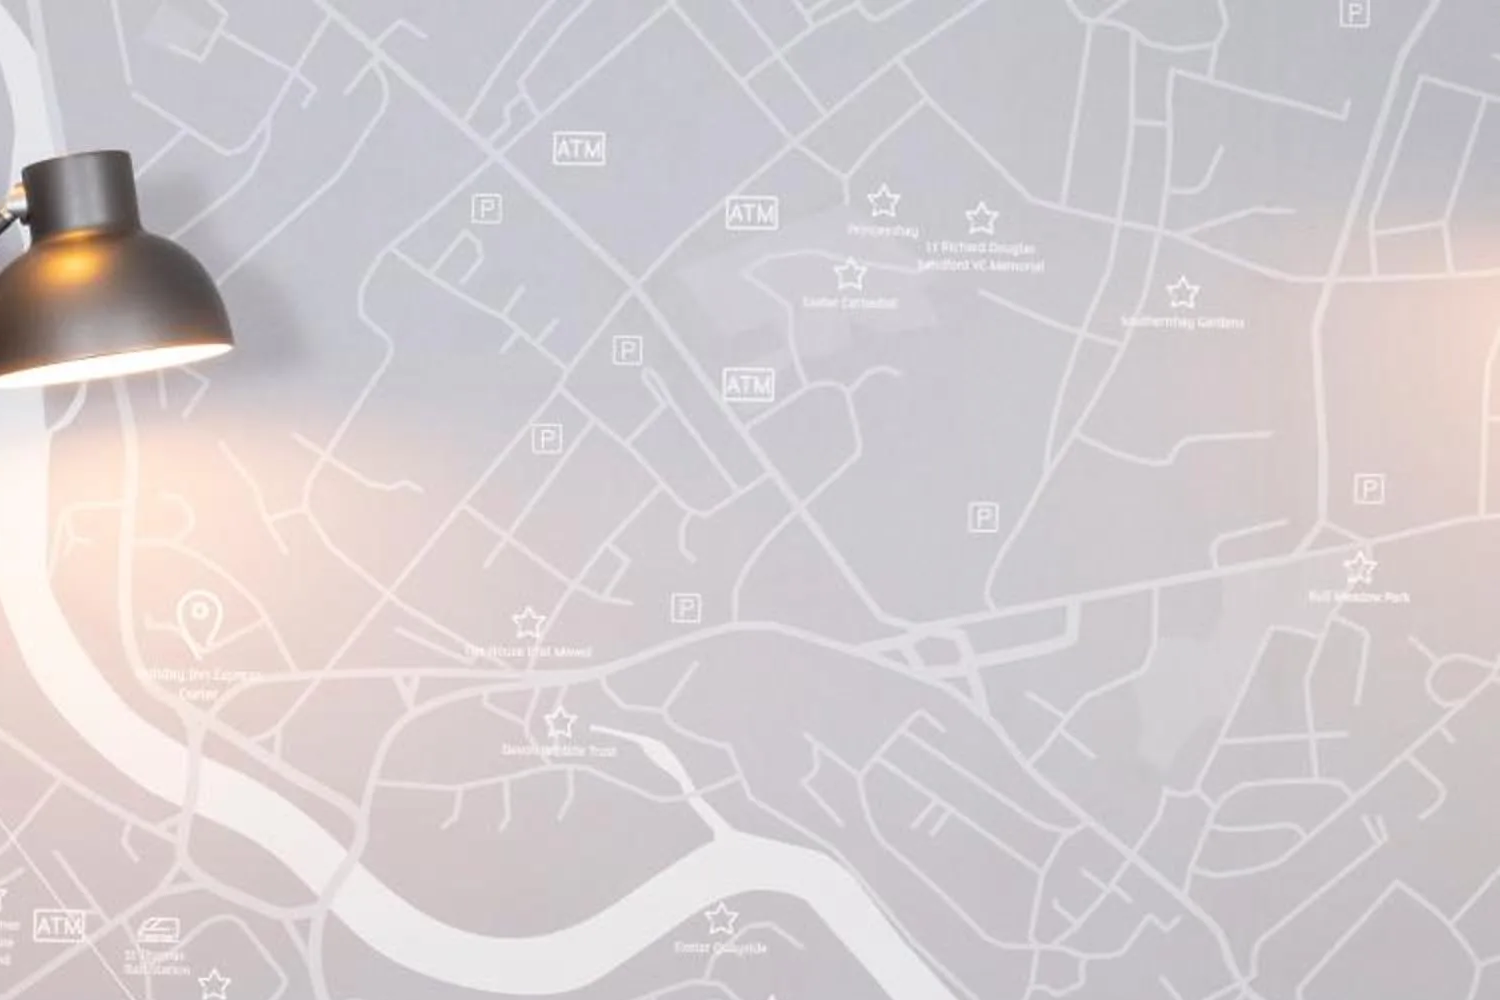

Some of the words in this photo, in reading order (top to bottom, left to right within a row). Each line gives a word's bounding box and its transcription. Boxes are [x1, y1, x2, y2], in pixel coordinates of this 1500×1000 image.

[558, 138, 601, 159] ATM
[729, 203, 774, 223] ATM
[727, 375, 771, 394] ATM
[36, 916, 83, 936] ATM
